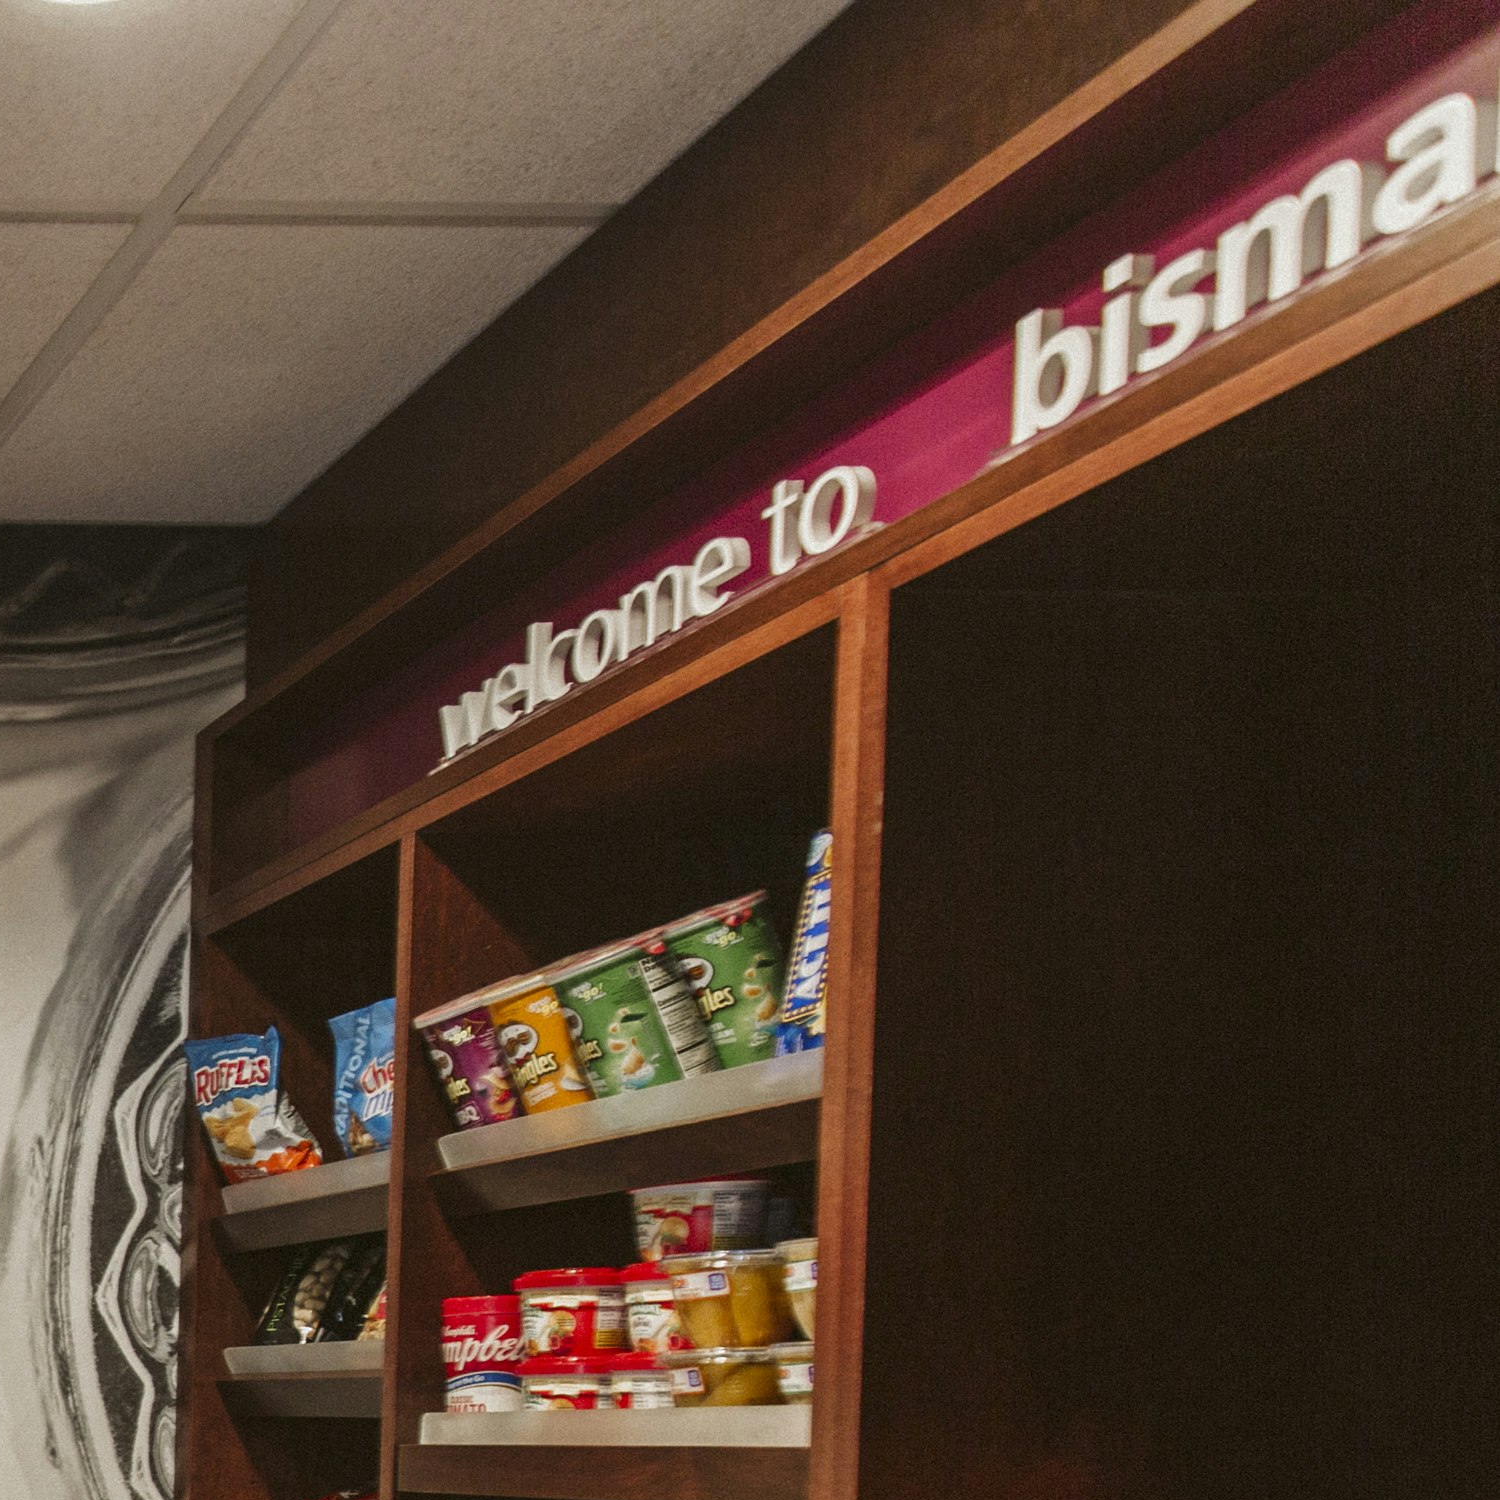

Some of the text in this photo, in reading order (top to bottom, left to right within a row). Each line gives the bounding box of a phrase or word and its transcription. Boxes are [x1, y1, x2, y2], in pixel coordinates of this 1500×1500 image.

[438, 64, 1500, 760] welcome to bisma
[194, 1055, 271, 1107] RUFFLES
